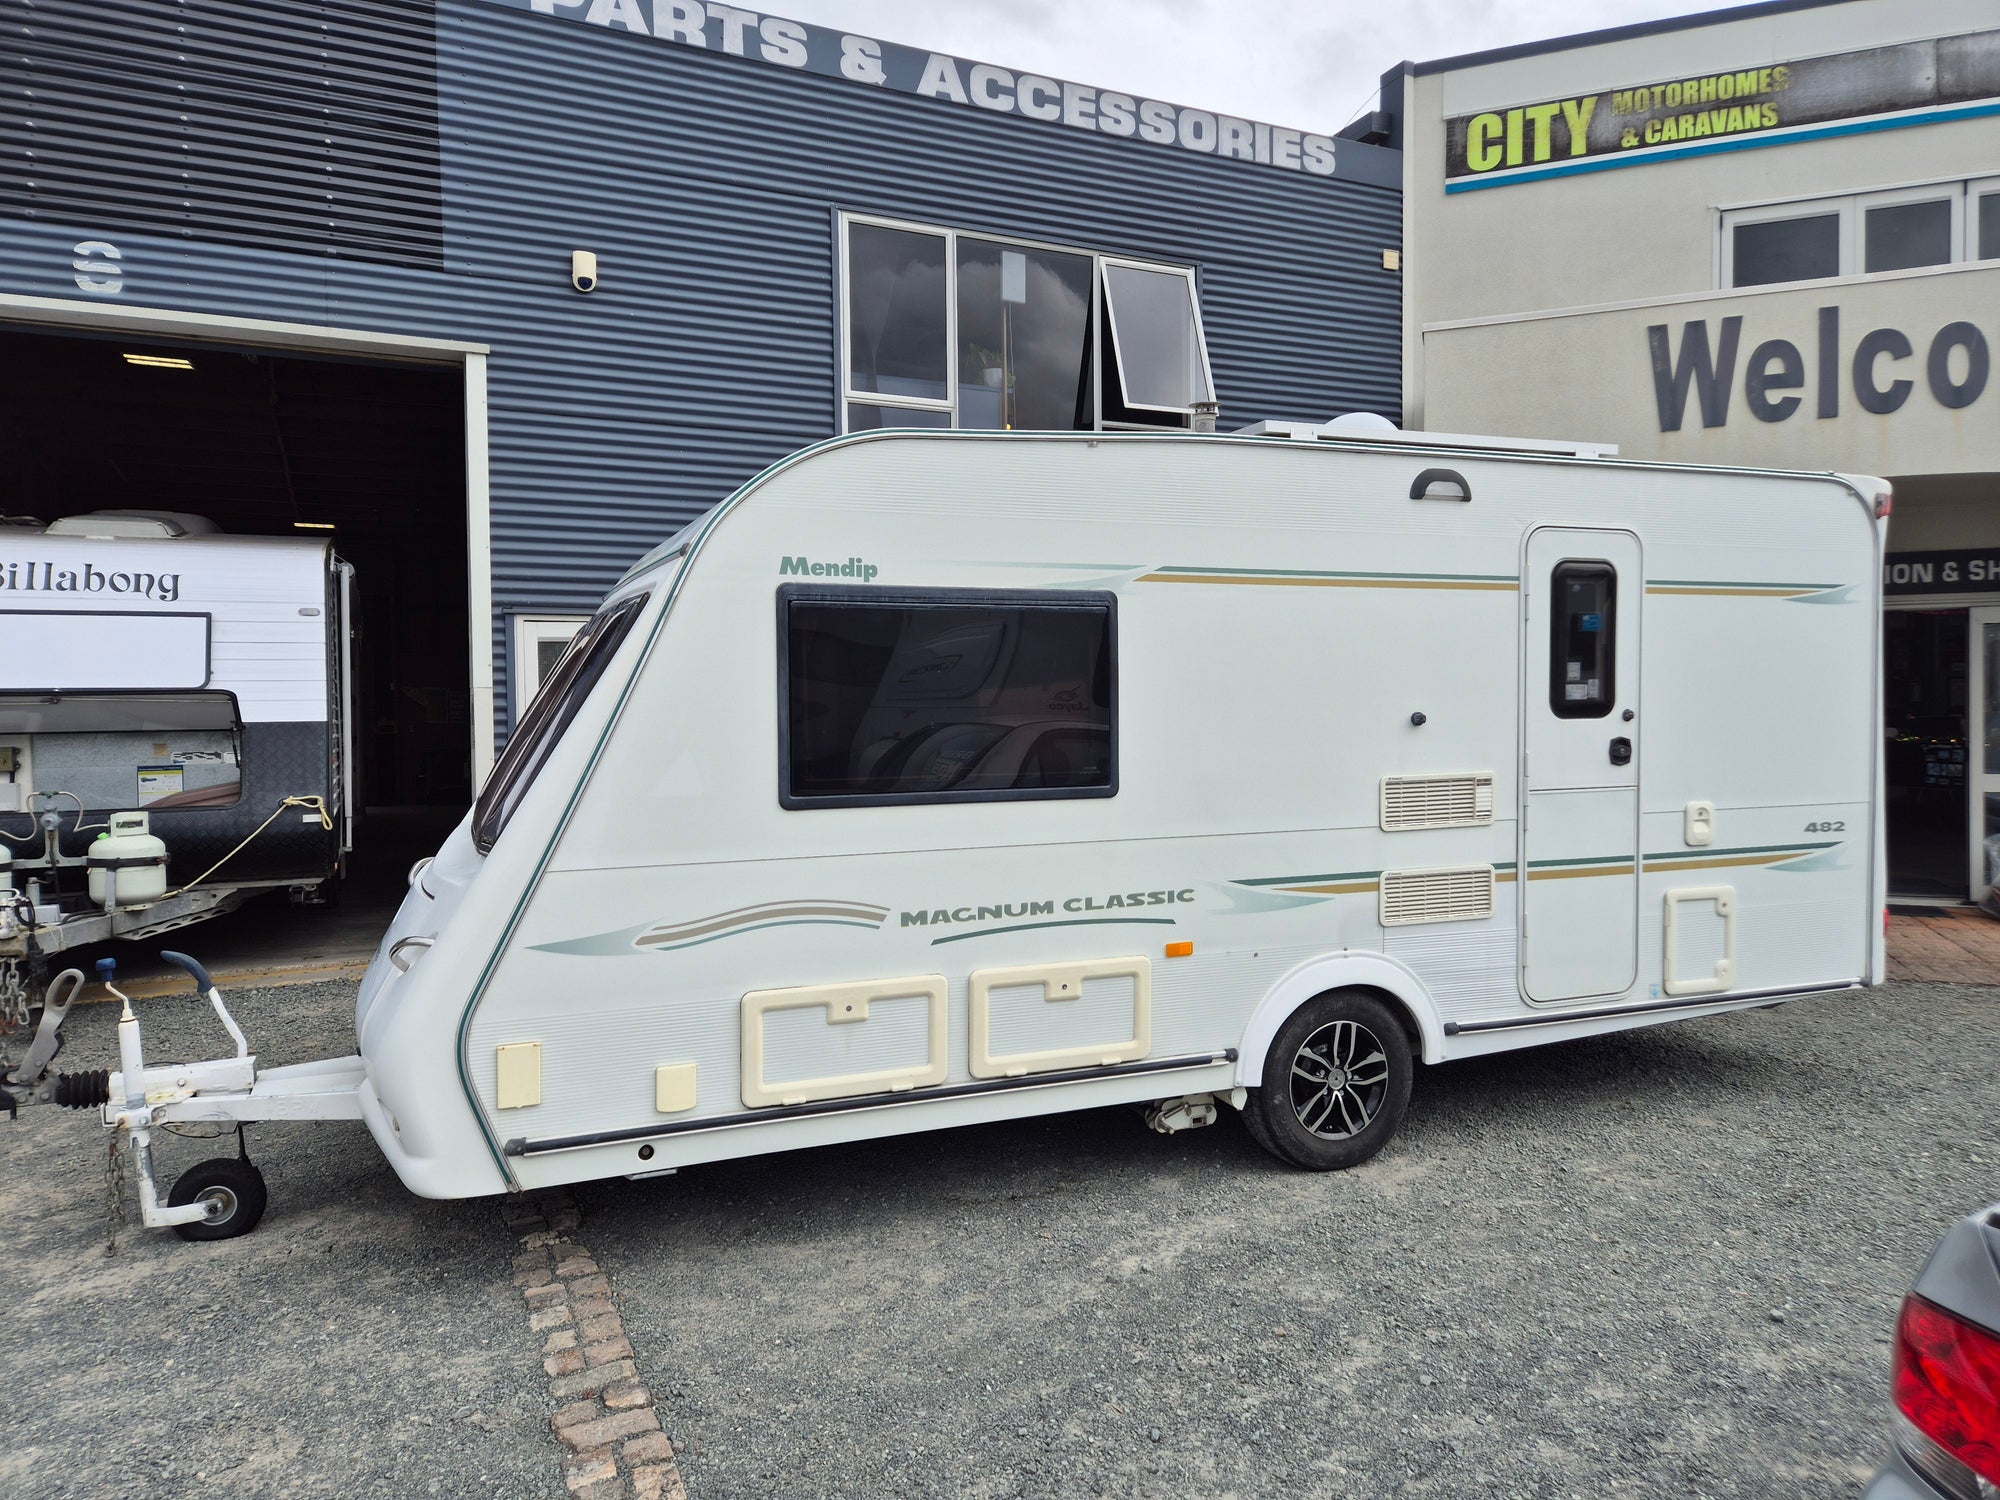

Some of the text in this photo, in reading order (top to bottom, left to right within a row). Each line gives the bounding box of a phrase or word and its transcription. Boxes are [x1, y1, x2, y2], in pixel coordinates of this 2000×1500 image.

[840, 35, 886, 85] &
[915, 55, 1337, 175] ACCESSORIES
[1612, 65, 1790, 118] MOTORHOMES
[1466, 96, 1600, 173] CITY
[1621, 102, 1779, 148] & CARAVANS
[1647, 305, 1990, 432] Welco
[0, 561, 182, 602] illabong
[779, 556, 878, 583] Mendip
[1942, 561, 1960, 582] &
[1803, 820, 1846, 833] 482
[900, 888, 1196, 928] MAGNUM CLASSIC
